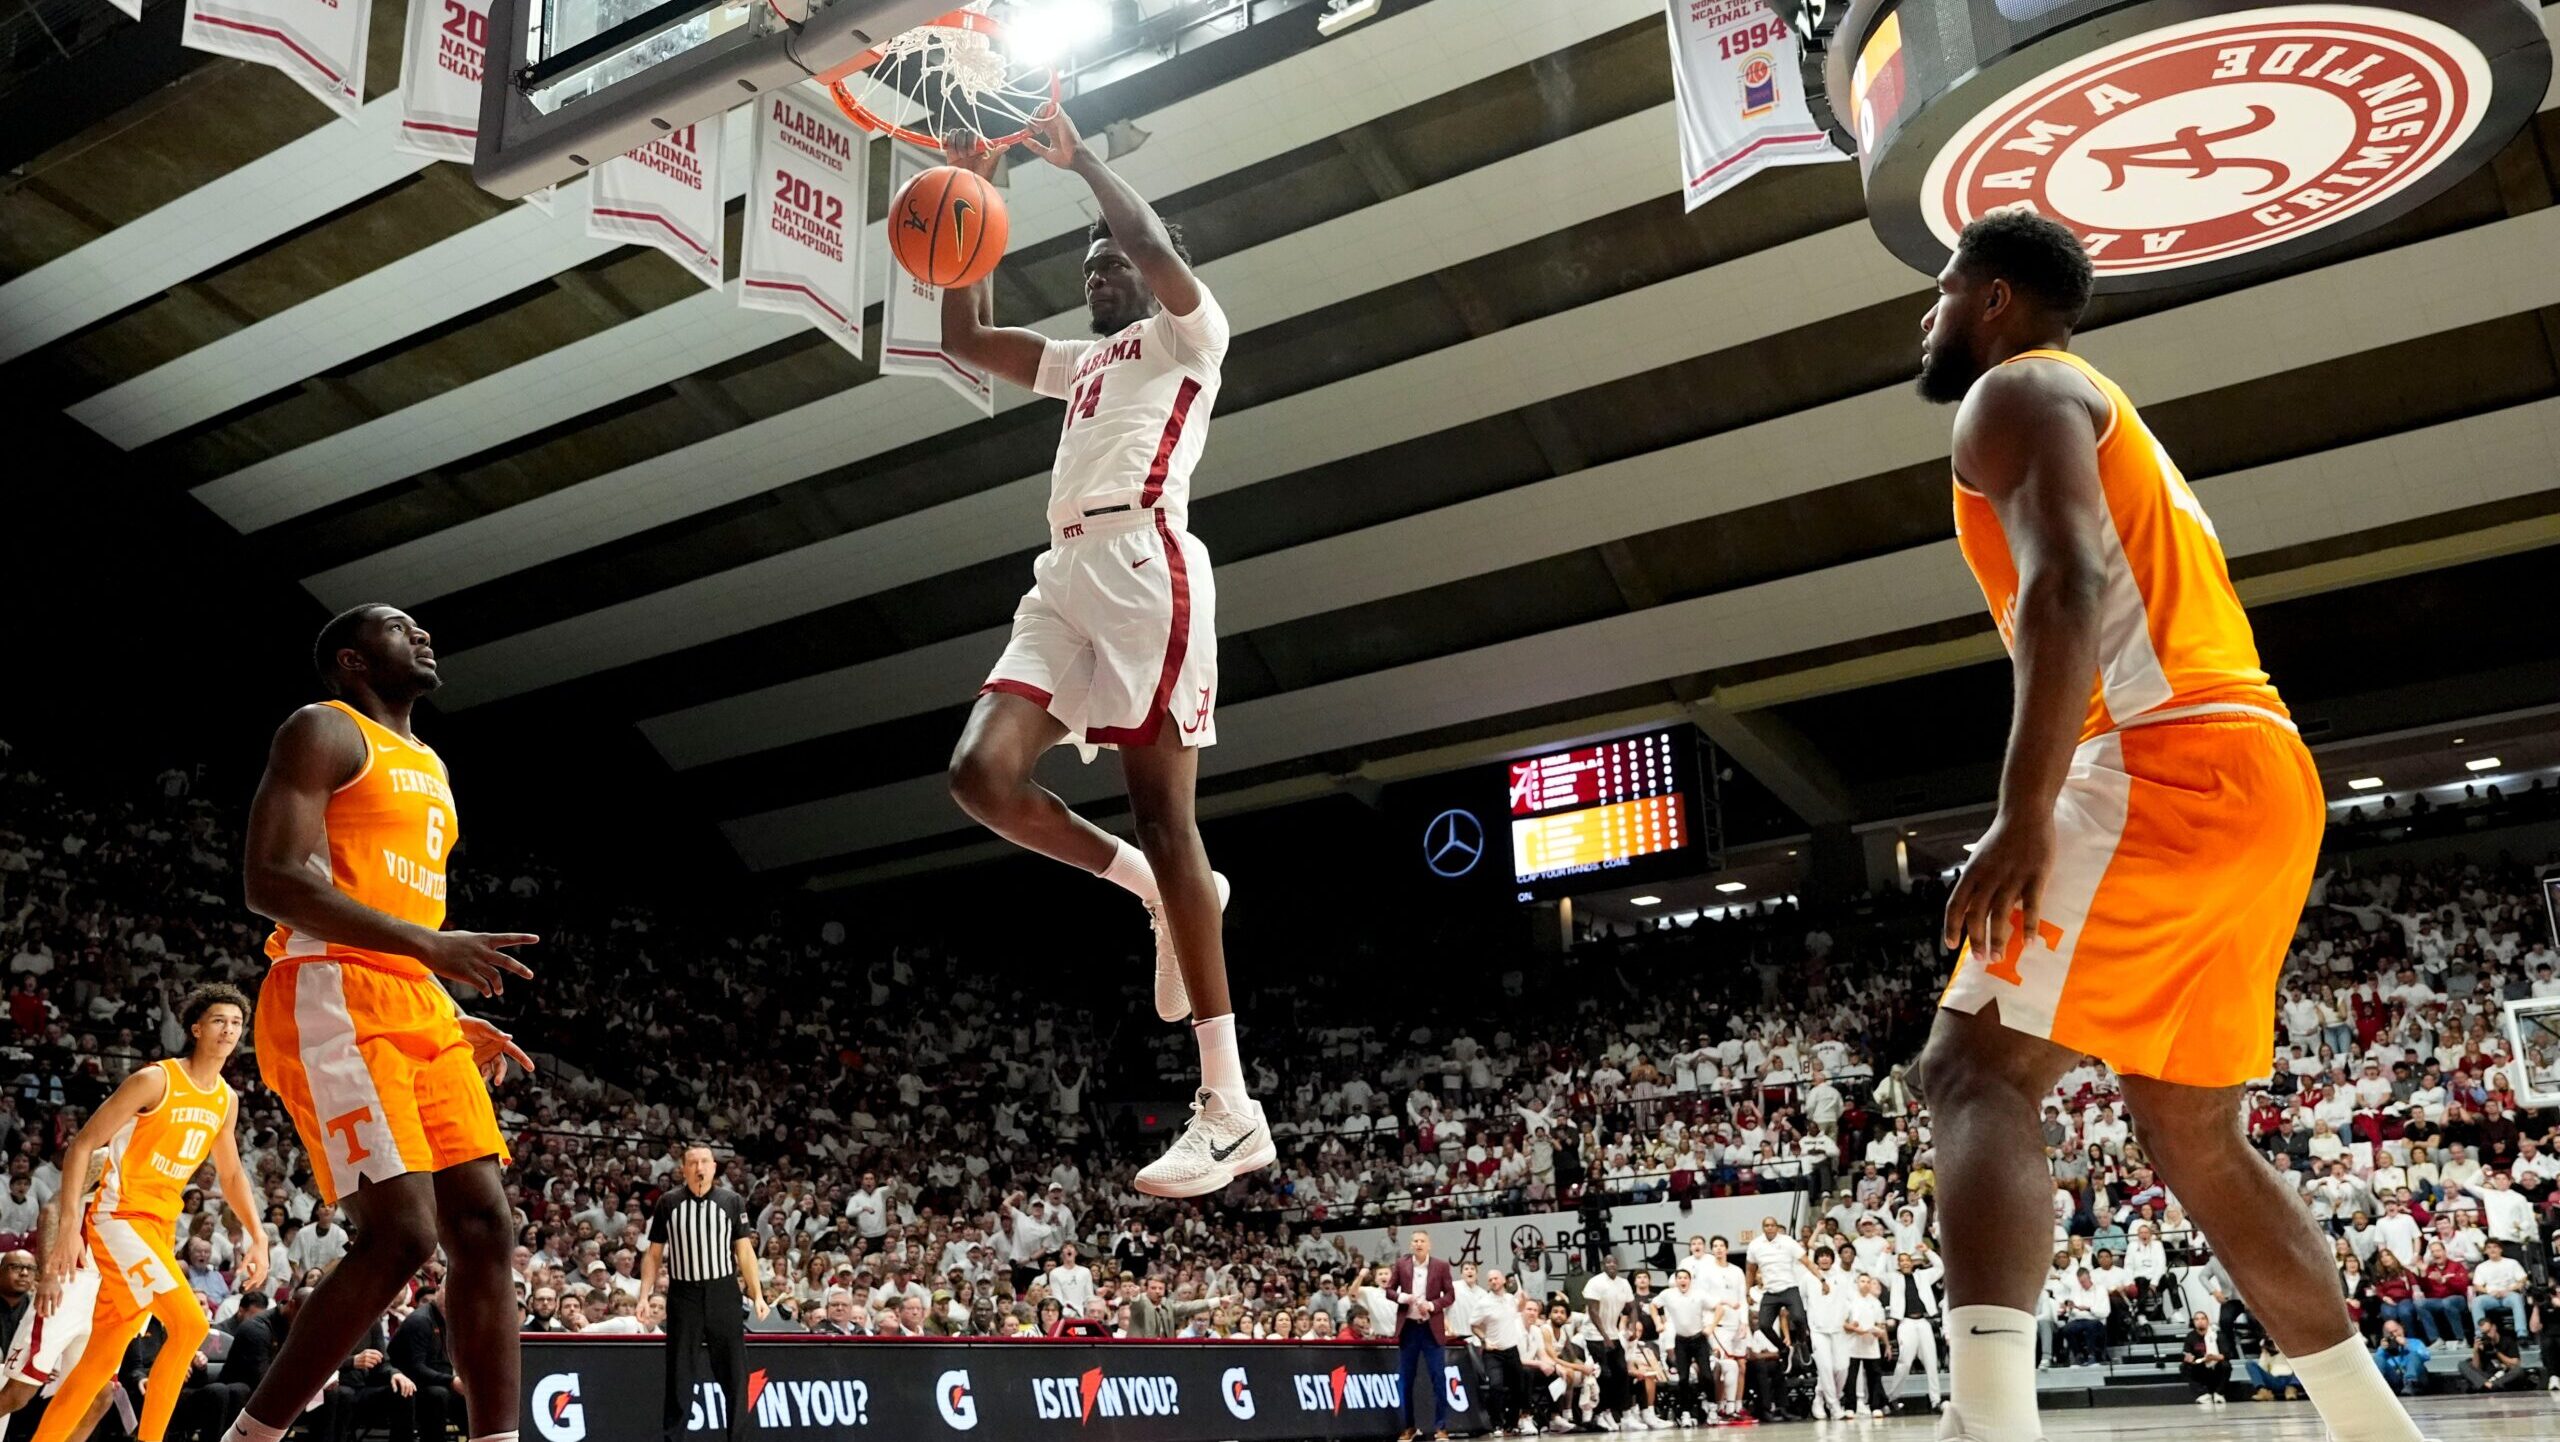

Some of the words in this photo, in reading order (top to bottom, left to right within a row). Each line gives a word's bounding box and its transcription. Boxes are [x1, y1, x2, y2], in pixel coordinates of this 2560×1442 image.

[1692, 5, 1722, 22] NCAA
[1708, 6, 1751, 29] FINAL
[1718, 16, 1787, 60] 1994
[2212, 43, 2383, 87] TIDE
[773, 100, 851, 160] ALABAMA
[780, 131, 842, 172] GYMNASTICS
[2087, 104, 2291, 196] A
[2253, 72, 2428, 228] CRIMSON
[776, 169, 843, 229] 2012
[772, 217, 843, 262] CHAMPIONS
[773, 202, 843, 248] NATIONAL
[1068, 373, 1104, 429] 14
[1063, 523, 1084, 539] RTR
[426, 806, 445, 861] 6
[178, 1128, 207, 1160] 10
[326, 1106, 373, 1165] T
[1623, 1222, 1677, 1245] TIDE
[127, 1257, 156, 1288] T
[532, 1372, 586, 1442] G
[756, 1381, 792, 1428] IN
[788, 1380, 868, 1427] YOU?
[936, 1369, 978, 1430] G
[1032, 1378, 1061, 1419] IS
[1057, 1377, 1082, 1419] IT
[1097, 1377, 1124, 1417] IN
[1122, 1376, 1180, 1416] YOU?
[1221, 1367, 1256, 1420] G
[1293, 1374, 1318, 1410] IS
[1312, 1374, 1335, 1410] IT
[1343, 1374, 1366, 1409] IN
[1359, 1373, 1400, 1409] YOU
[1443, 1366, 1470, 1412] G
